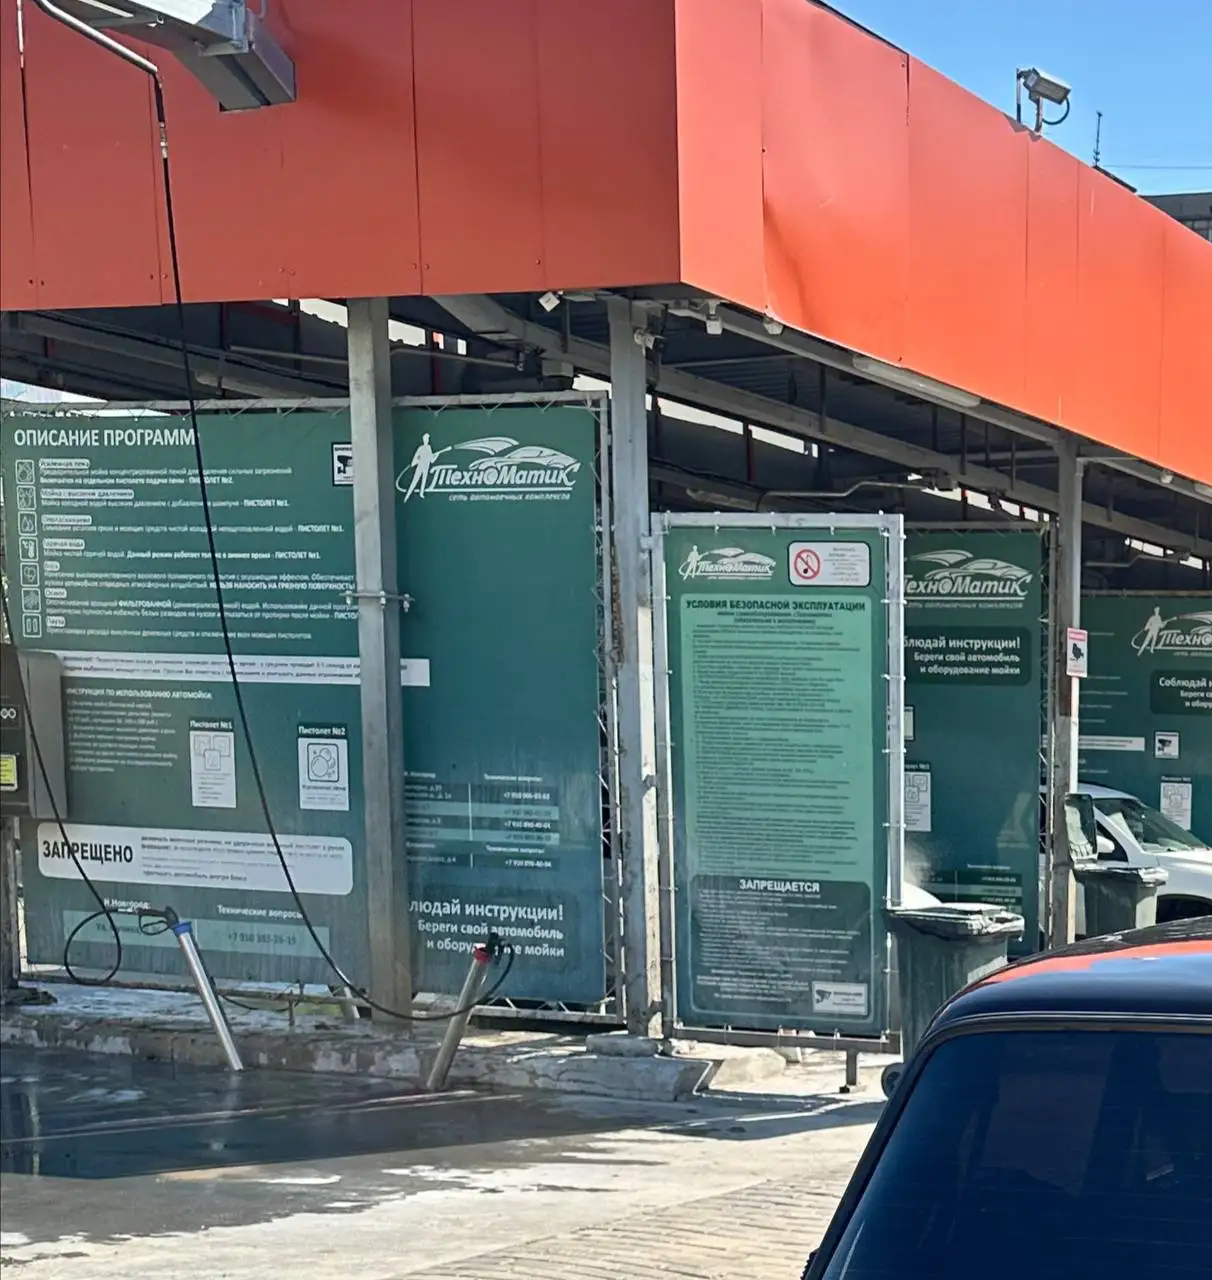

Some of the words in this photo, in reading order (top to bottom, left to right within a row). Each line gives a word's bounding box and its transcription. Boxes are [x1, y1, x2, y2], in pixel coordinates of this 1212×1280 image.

[14, 428, 100, 446] ОПИСАНИЕ
[686, 599, 728, 609] УСЛОВИЯ
[729, 600, 790, 610] БЕЗОПАСНОЙ
[792, 600, 866, 612] ЭКСПЛУАТАЦИИ
[903, 636, 946, 649] блюдай
[948, 637, 1020, 651] инструкции!
[913, 651, 944, 663] Береги
[944, 652, 966, 661] свой
[967, 652, 1020, 662] автомобиль
[927, 665, 990, 676] оборудование
[1158, 676, 1207, 689] Соблюдай
[43, 840, 133, 864] ЗАПРЕЩЕНО
[739, 878, 820, 893] ЗАПРЕЩАЕТСЯ
[408, 898, 461, 917] людай
[465, 903, 564, 922] инструкции!
[417, 919, 458, 934] Береги
[460, 921, 488, 936] свой
[426, 938, 434, 949] и
[524, 943, 565, 957] мойки
